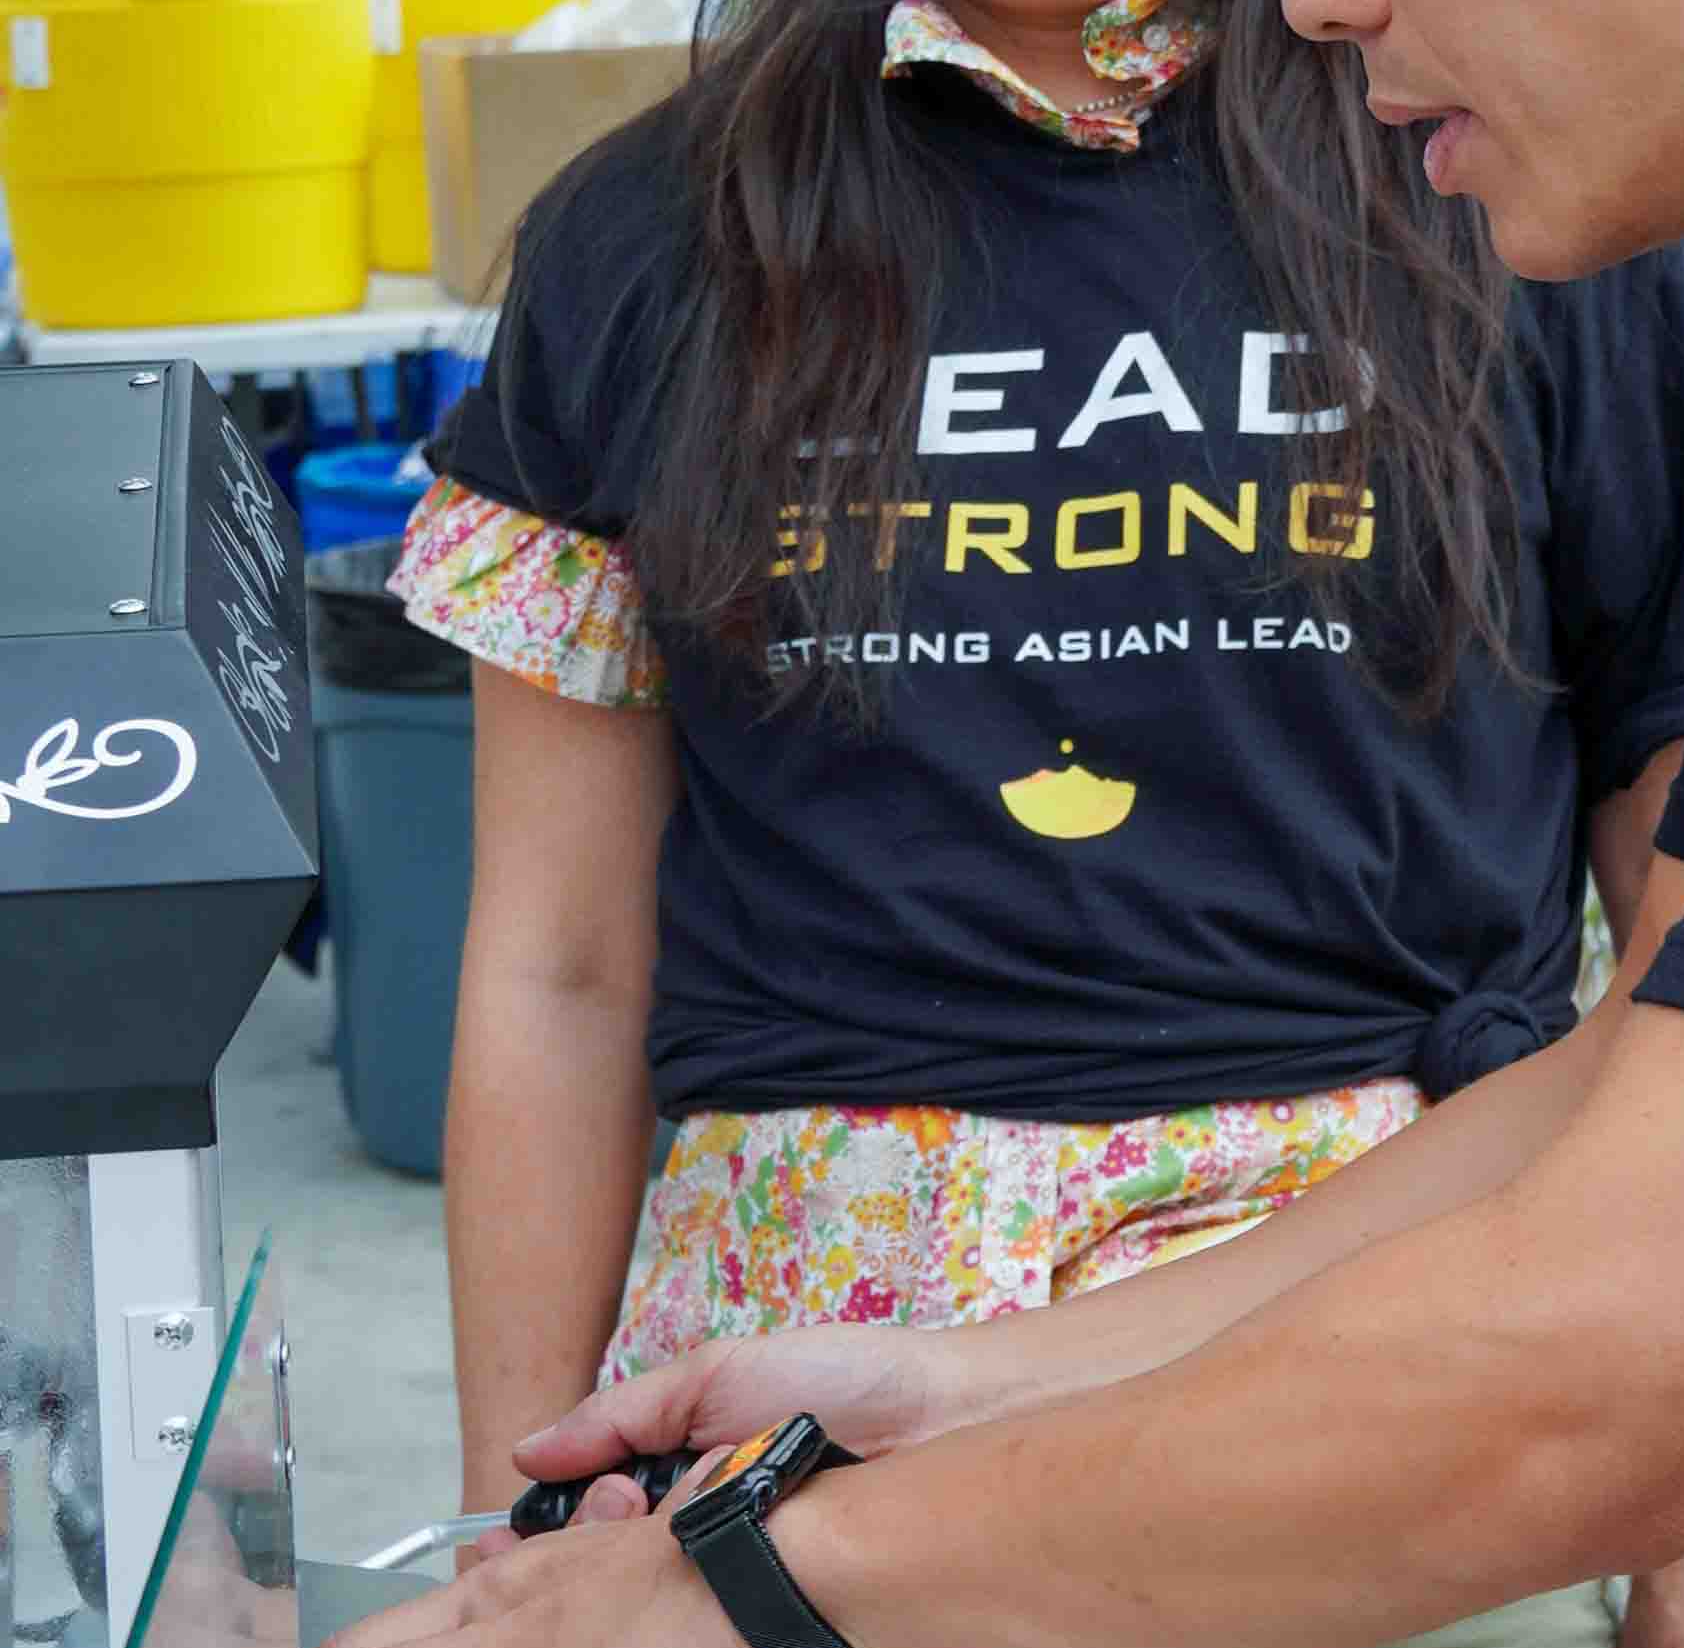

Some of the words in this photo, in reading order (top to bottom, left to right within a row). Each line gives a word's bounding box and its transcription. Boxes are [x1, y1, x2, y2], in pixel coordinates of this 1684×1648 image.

[797, 331, 1376, 456] EAD
[1013, 618, 1190, 663] ASIAN
[1217, 617, 1352, 654] LEAD
